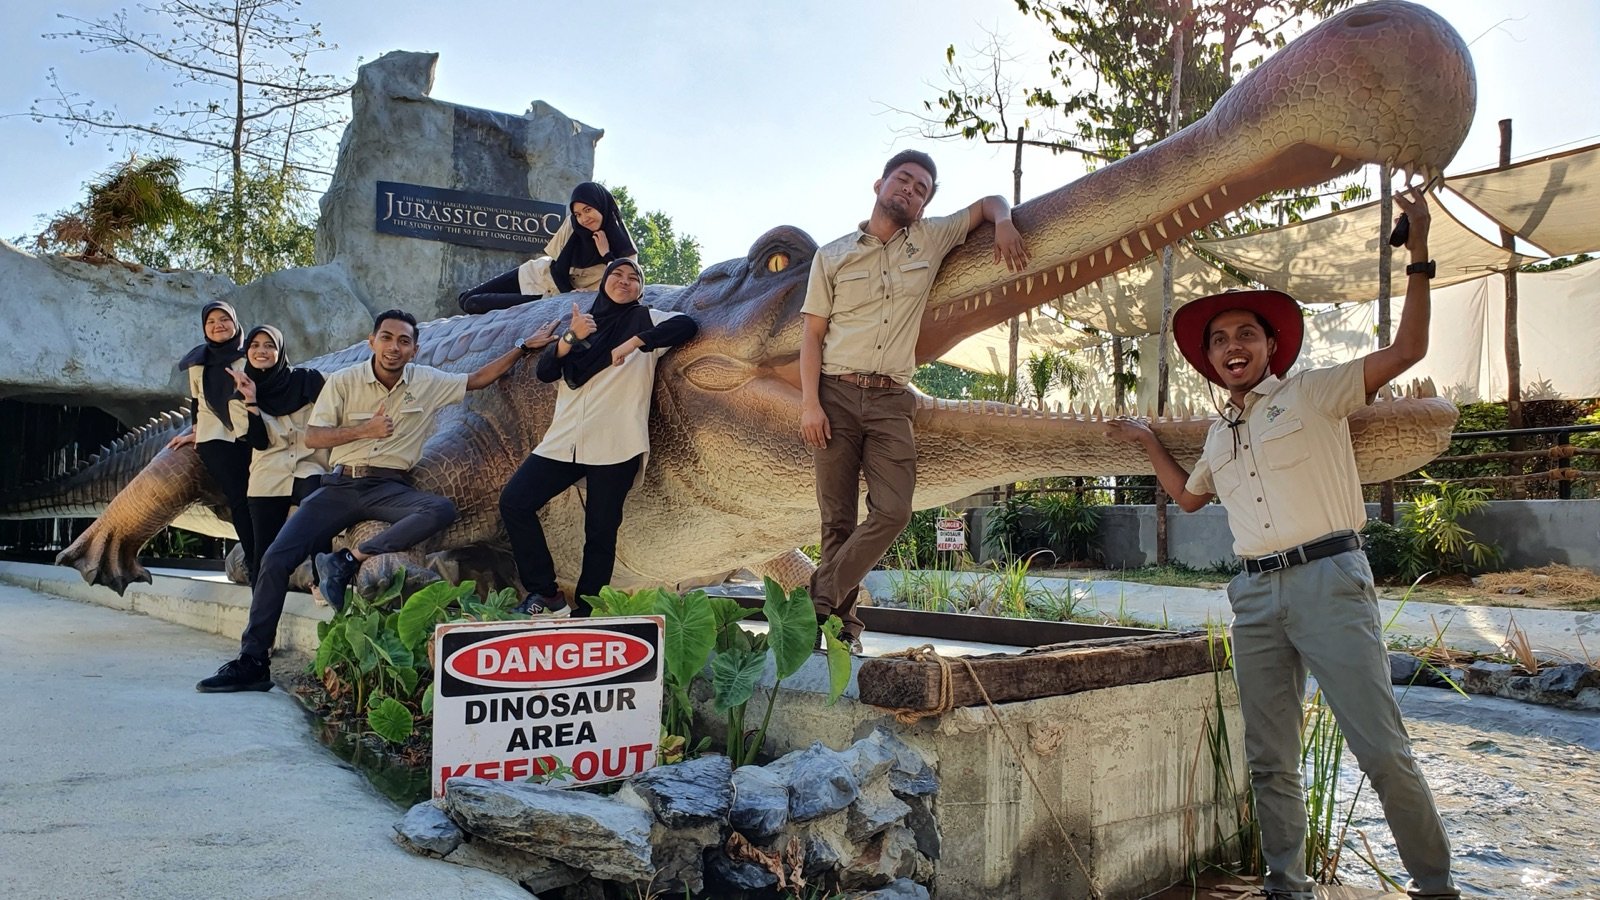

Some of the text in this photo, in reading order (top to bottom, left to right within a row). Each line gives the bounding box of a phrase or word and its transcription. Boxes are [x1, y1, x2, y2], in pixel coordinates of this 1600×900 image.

[383, 192, 561, 236] JURASSIC CROC
[409, 221, 433, 230] STORY
[447, 226, 461, 234] THE
[472, 229, 490, 237] FEET
[490, 232, 511, 240] LONG
[477, 641, 629, 676] DANGER
[465, 688, 636, 725] DINOSAUR
[506, 721, 597, 753] AREA
[572, 743, 653, 782] OUT
